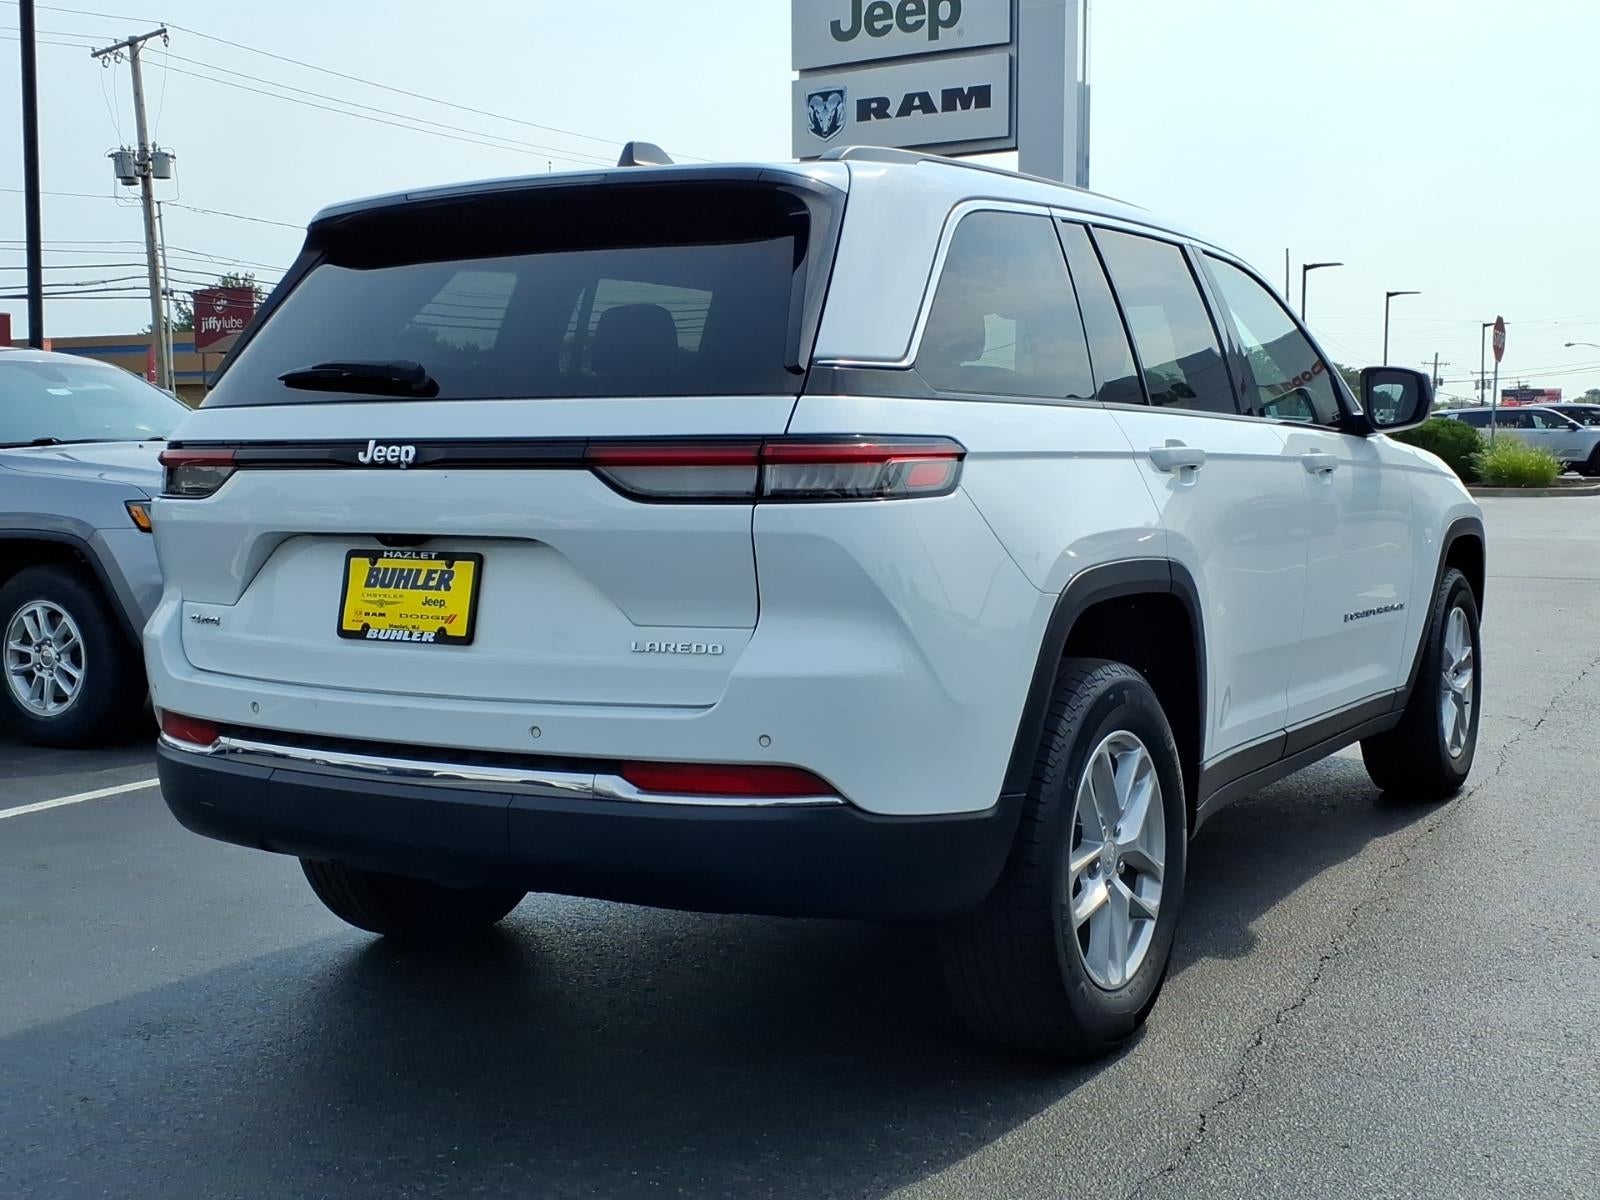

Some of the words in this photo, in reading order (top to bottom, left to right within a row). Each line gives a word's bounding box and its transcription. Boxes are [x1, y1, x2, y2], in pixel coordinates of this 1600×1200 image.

[830, 0, 961, 42] Jeep
[856, 84, 992, 122] RAM
[201, 316, 221, 333] jiffy
[222, 316, 243, 329] lube
[358, 440, 416, 469] Jeep
[383, 551, 438, 559] HAZLET
[364, 566, 455, 591] BUHLER
[421, 596, 446, 608] Jeep
[399, 613, 450, 621] DODGE
[366, 628, 435, 642] BUHLER
[631, 641, 724, 655] LAREDO
